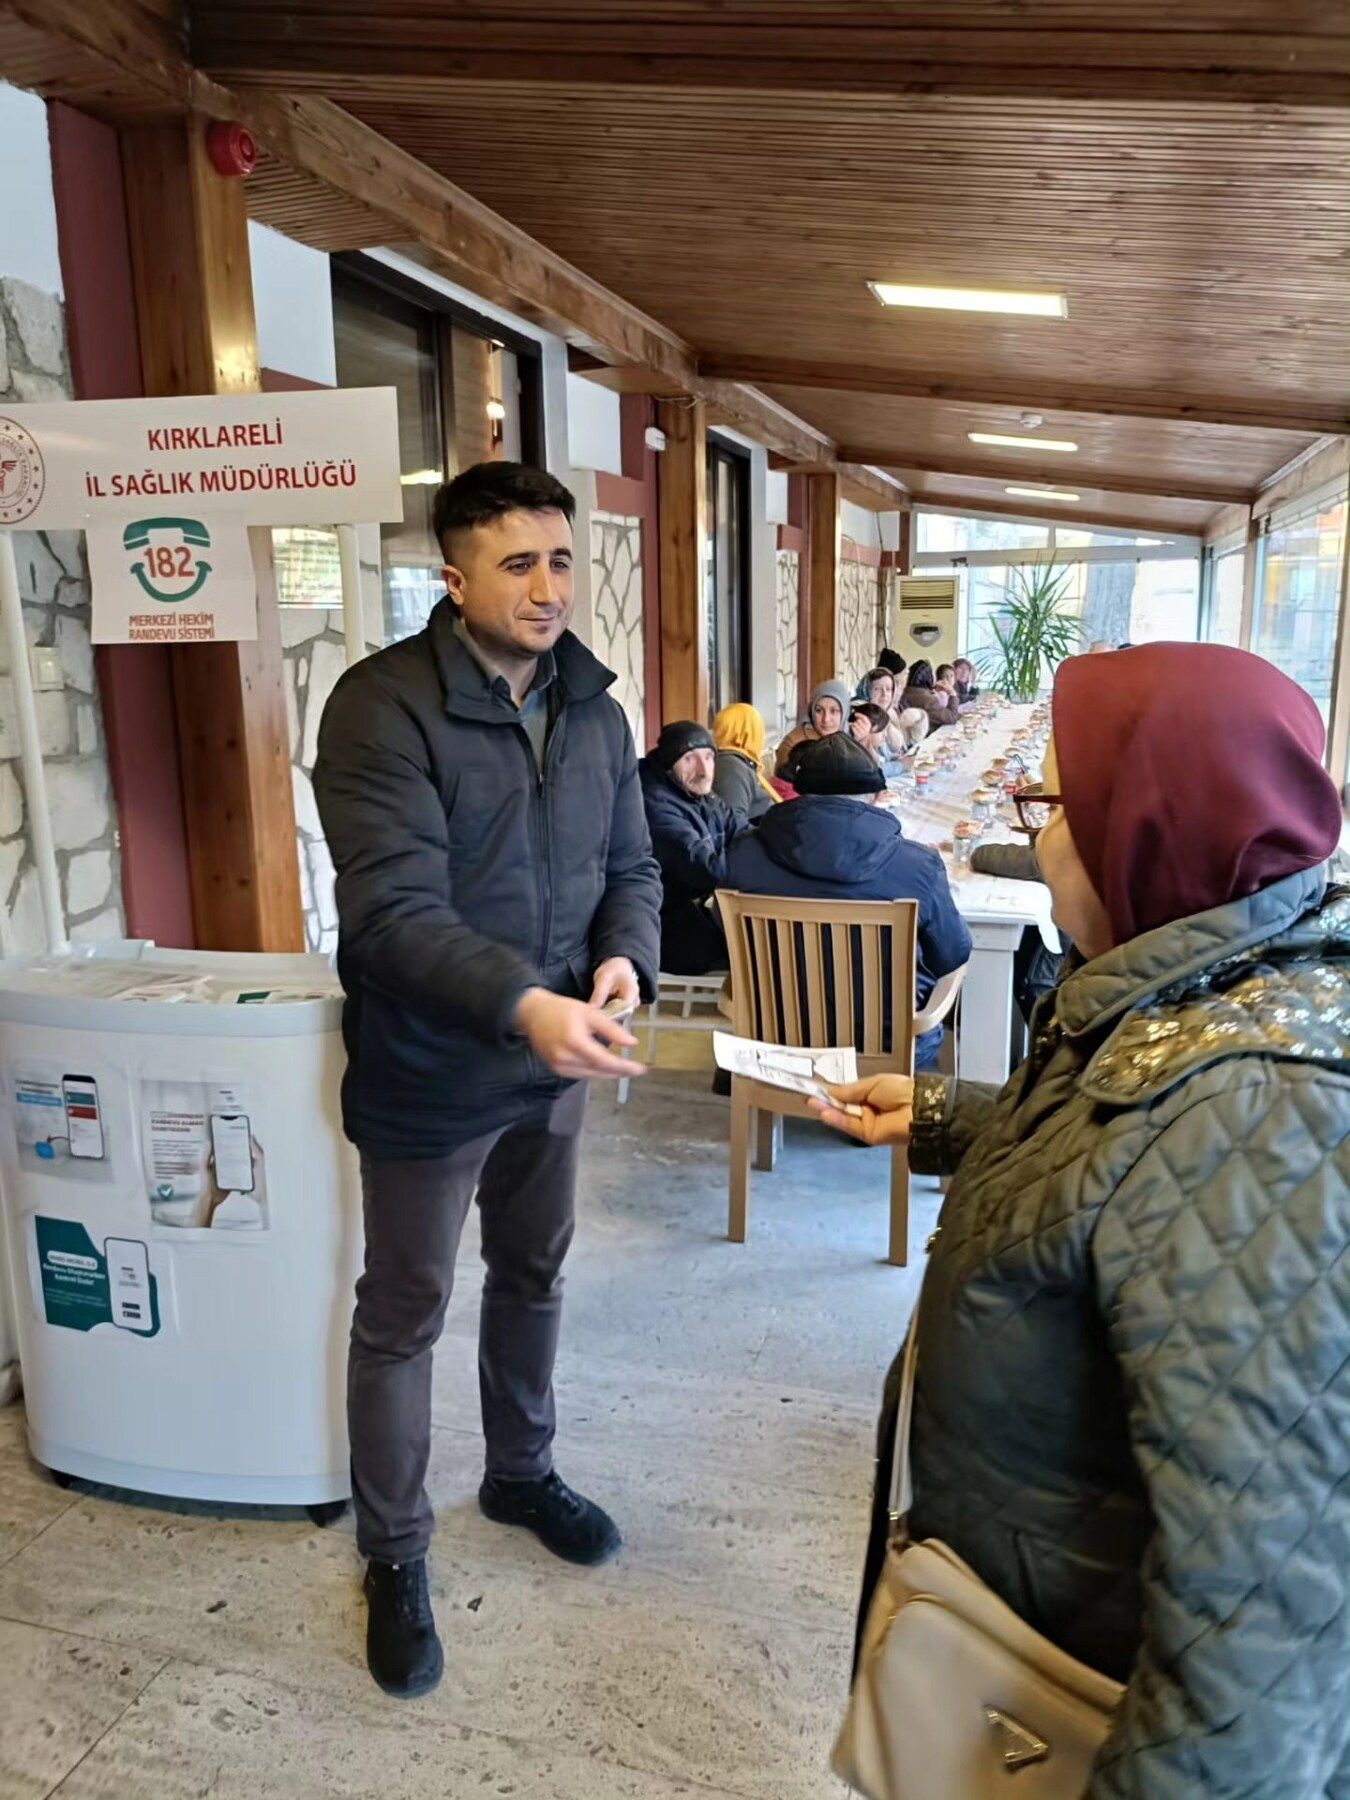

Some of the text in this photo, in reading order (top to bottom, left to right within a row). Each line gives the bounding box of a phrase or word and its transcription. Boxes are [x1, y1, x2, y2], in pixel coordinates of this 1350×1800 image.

[148, 417, 283, 451] KIRKLARELİ
[85, 459, 357, 497] İL SAĞLIK MÜDÜRLÜĞÜ
[144, 546, 195, 578] 182
[129, 628, 176, 640] RANDEVU
[178, 612, 214, 626] HEKİM
